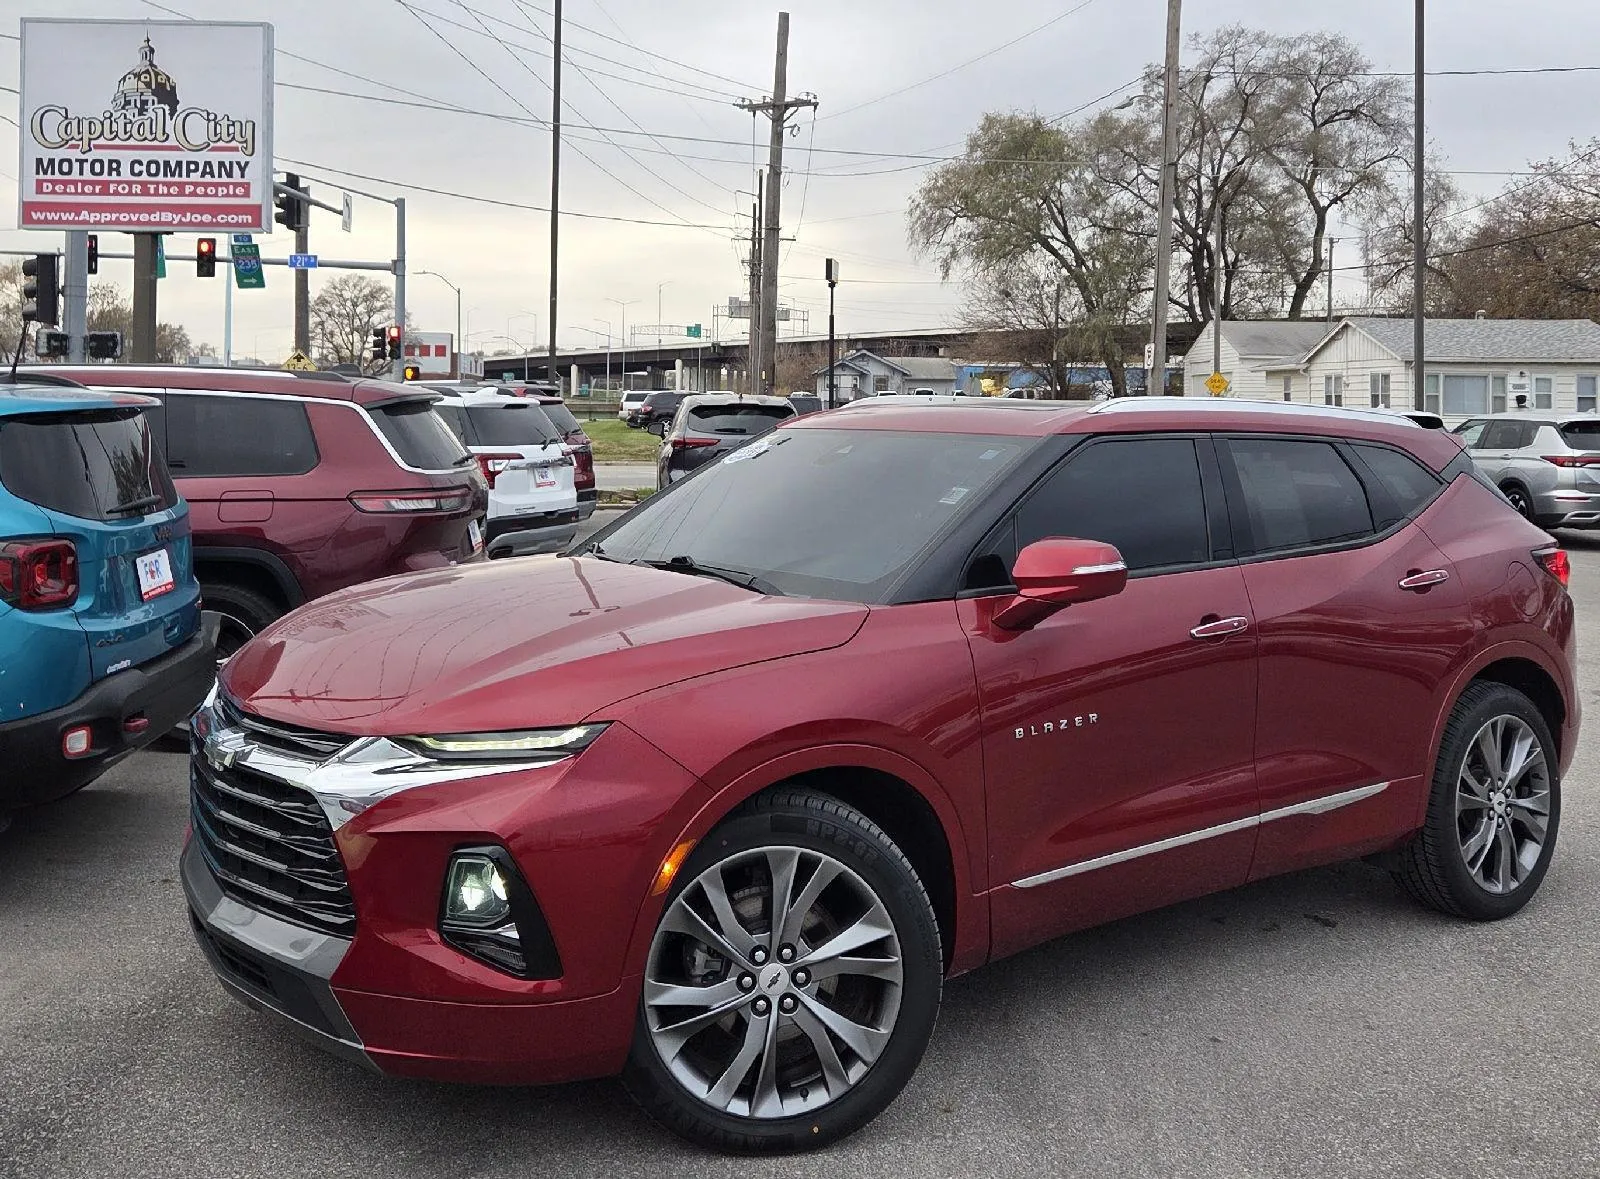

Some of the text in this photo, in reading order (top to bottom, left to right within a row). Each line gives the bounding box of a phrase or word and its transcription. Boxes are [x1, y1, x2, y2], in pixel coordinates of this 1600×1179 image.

[31, 104, 255, 156] Capital City
[35, 157, 250, 179] MOTOR COMPANY
[42, 182, 245, 197] Dealer FOR The People
[31, 210, 252, 225] www.ApprovedByJoe.com
[238, 260, 258, 270] 235
[1014, 713, 1098, 739] BLAZER
